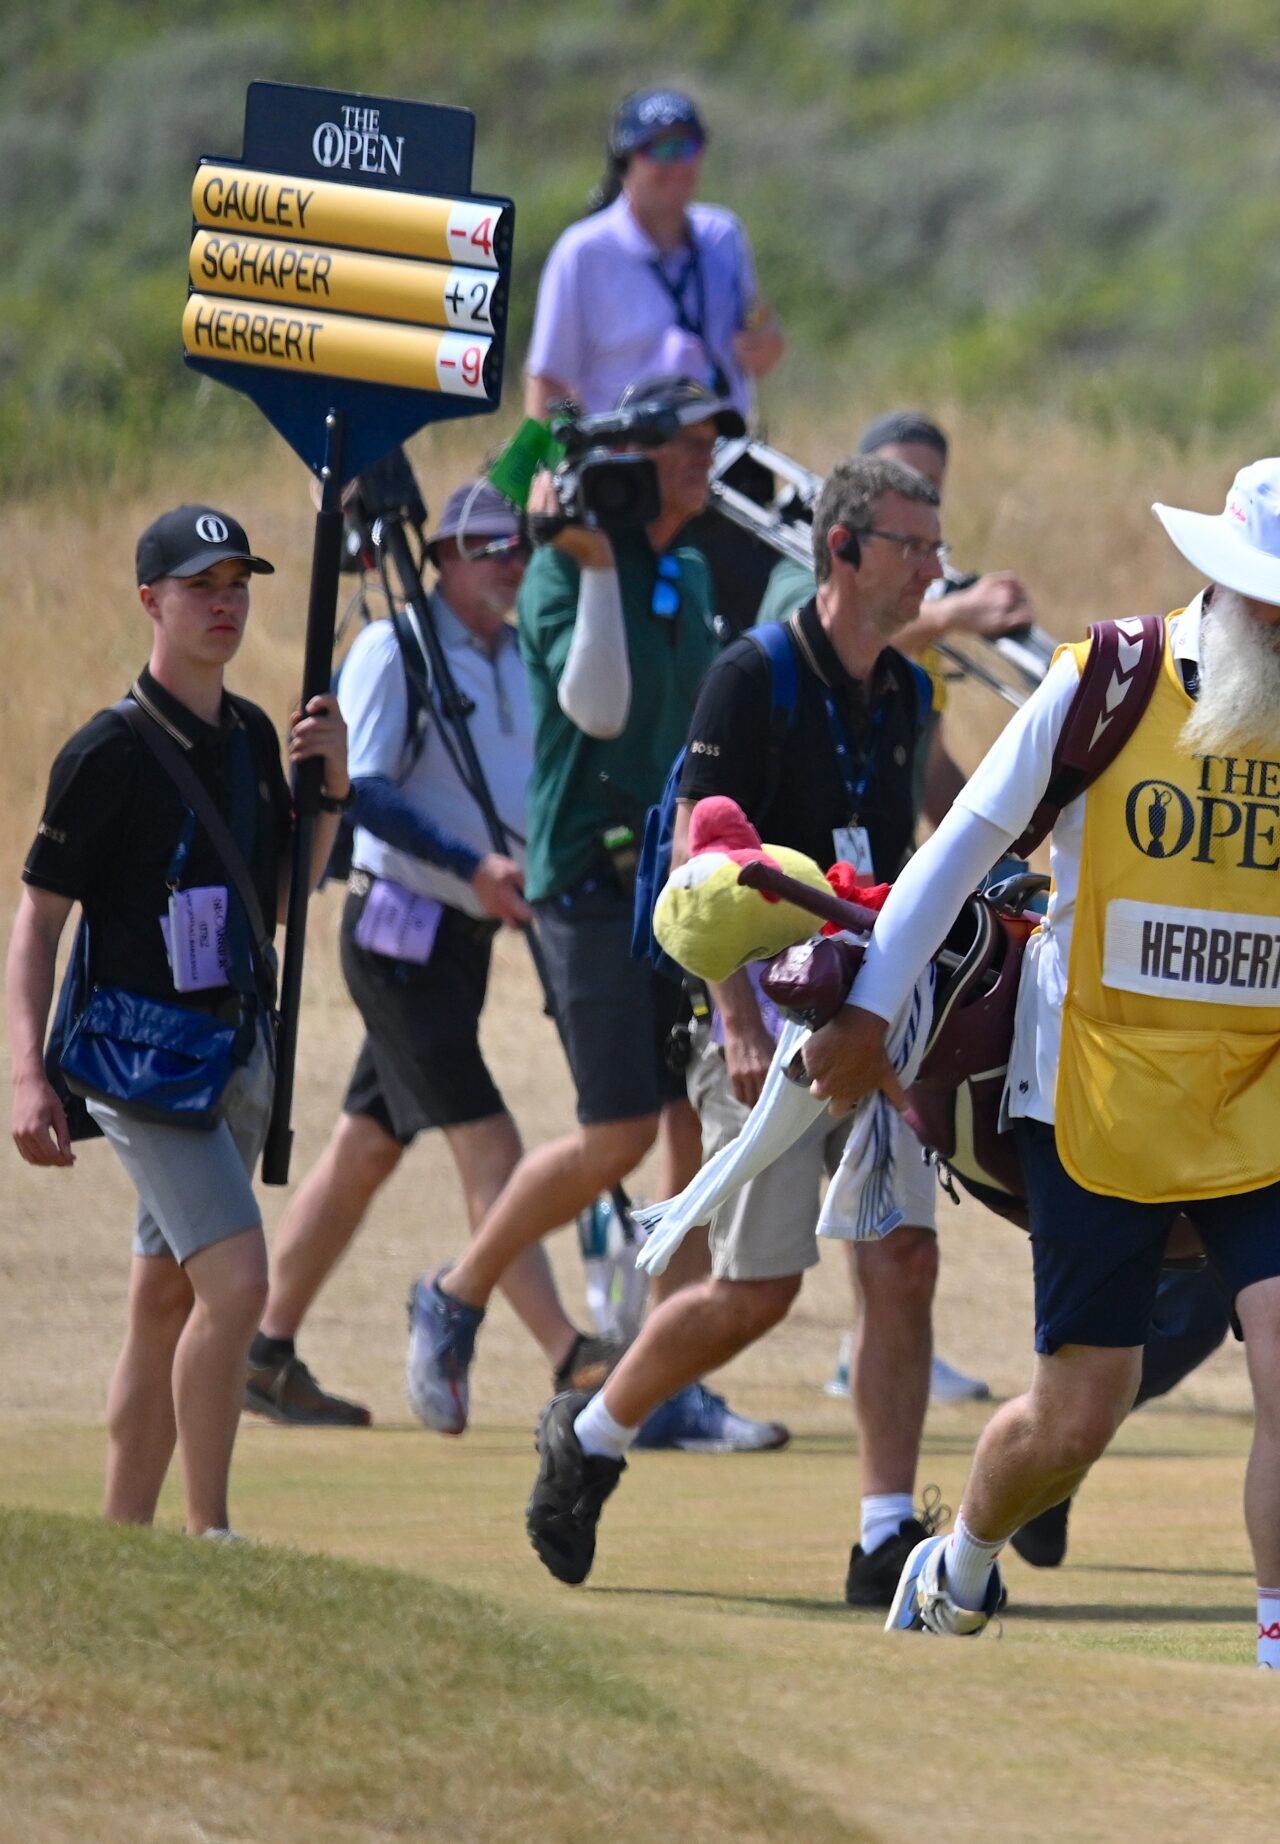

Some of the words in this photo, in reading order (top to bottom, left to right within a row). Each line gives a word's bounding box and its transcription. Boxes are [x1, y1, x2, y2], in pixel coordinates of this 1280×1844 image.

[312, 121, 405, 176] OPEN
[341, 105, 381, 133] THE
[202, 177, 315, 229] CAULEY
[449, 217, 493, 256] -4
[200, 238, 333, 296] SCHAPER
[444, 282, 490, 322] +2
[194, 306, 324, 362] HERBERT
[439, 346, 483, 386] -9
[691, 740, 720, 756] BOSS
